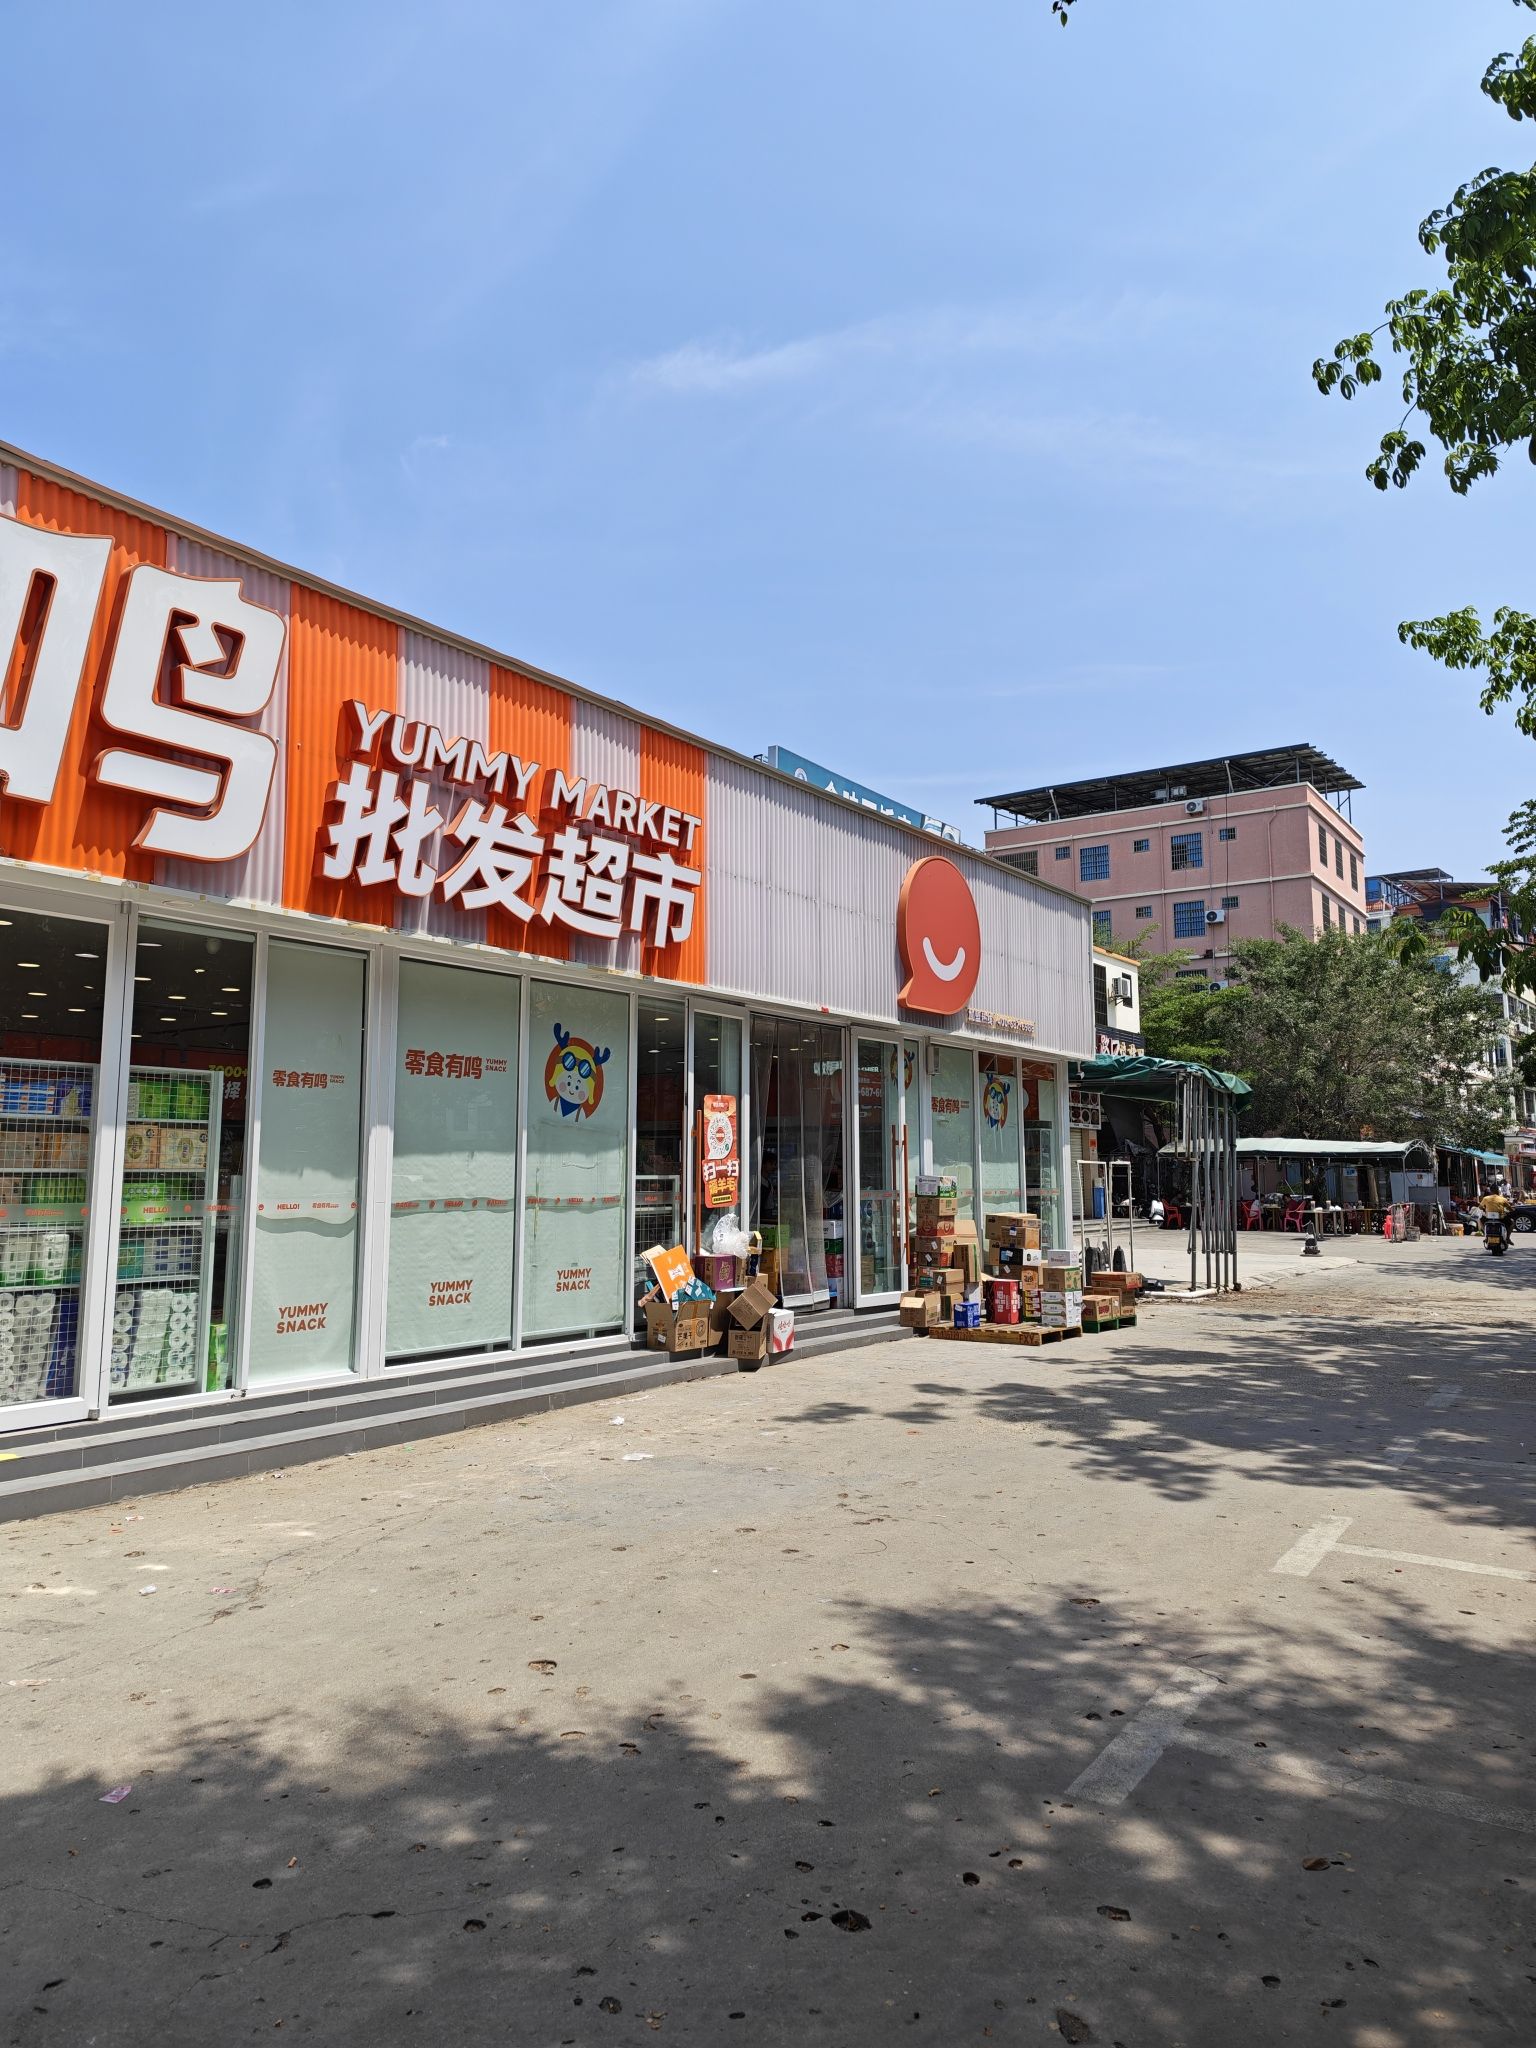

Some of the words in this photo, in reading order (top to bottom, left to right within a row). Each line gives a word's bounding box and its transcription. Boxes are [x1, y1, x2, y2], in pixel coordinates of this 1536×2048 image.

[351, 699, 541, 801] YUMMY
[549, 768, 702, 851] MARKET
[322, 761, 702, 949] 批发超市
[404, 1049, 483, 1080] 零食有鸣
[484, 1065, 507, 1073] SNACK
[485, 1058, 508, 1066] YUMMY
[272, 1070, 328, 1089] 零食有鸣
[703, 1160, 739, 1182] 扫一扫
[557, 1268, 592, 1280] YUMMY
[430, 1279, 473, 1293] YUMMY
[556, 1279, 591, 1292] SNACK
[428, 1292, 472, 1307] SNACK
[278, 1302, 329, 1320] YUMMY
[276, 1316, 327, 1334] SNACK
